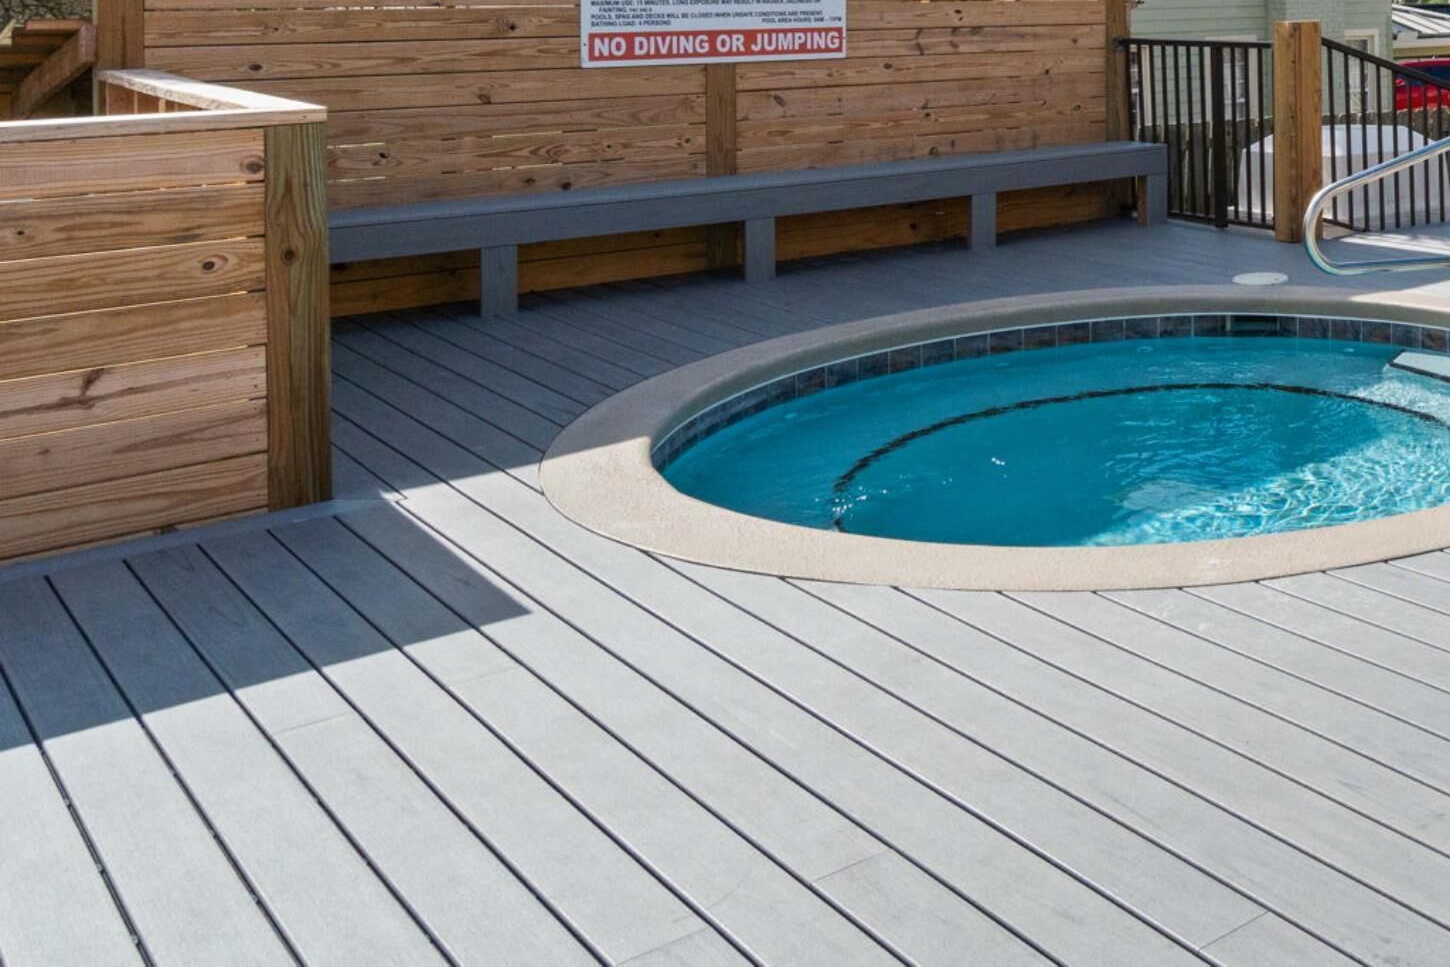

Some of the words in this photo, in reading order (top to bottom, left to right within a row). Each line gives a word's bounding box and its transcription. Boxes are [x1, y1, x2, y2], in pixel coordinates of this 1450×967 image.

[594, 37, 626, 57] NO
[633, 34, 709, 56] DIVING
[716, 33, 745, 53] OR
[751, 31, 840, 52] JUMPING
